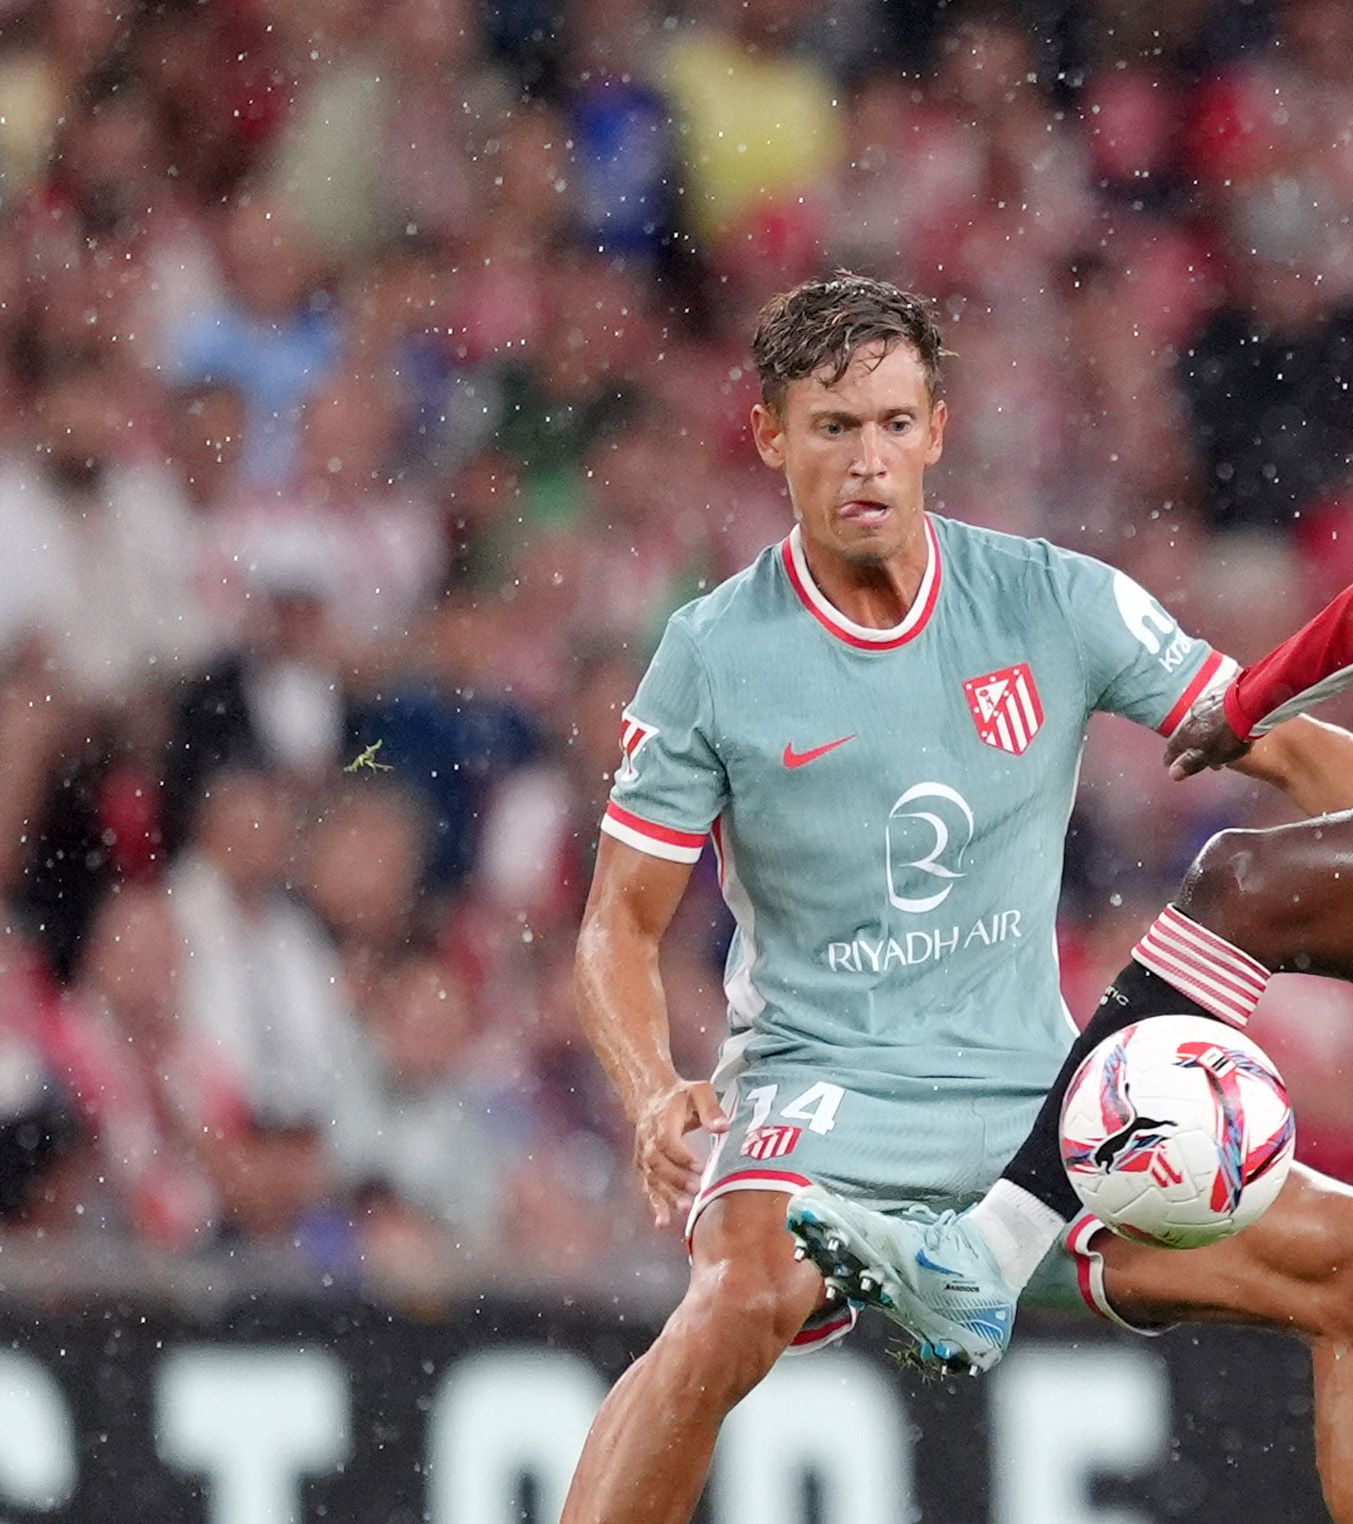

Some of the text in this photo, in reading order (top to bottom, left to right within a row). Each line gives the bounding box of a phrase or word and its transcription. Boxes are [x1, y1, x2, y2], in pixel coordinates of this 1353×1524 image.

[828, 909, 1022, 973] RIYADH AIR
[745, 1081, 846, 1136] 14
